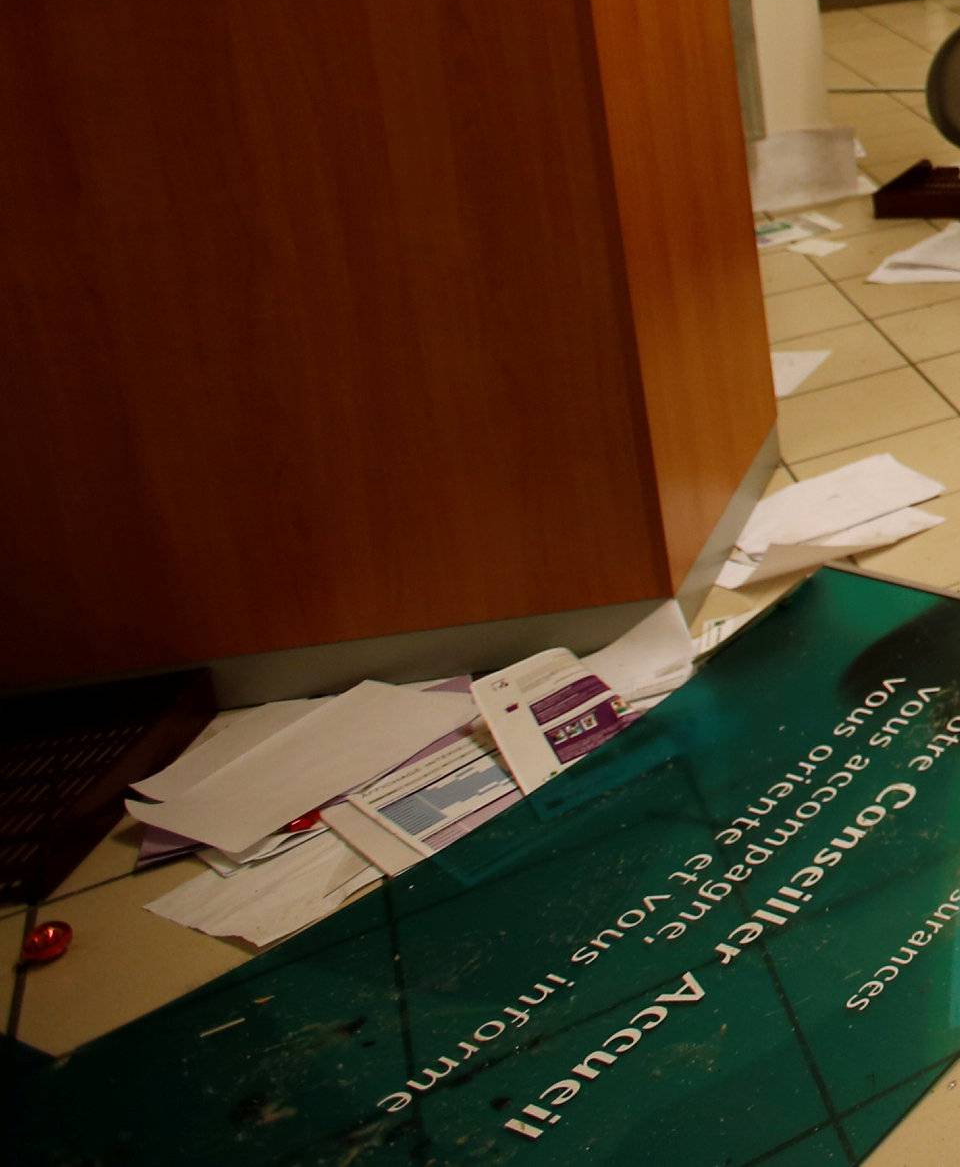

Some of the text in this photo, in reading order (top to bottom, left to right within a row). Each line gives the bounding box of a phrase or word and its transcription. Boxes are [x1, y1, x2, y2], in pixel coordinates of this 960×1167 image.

[377, 676, 907, 1113] vous oriente et vous informe
[642, 686, 942, 945] vous accompagne,
[714, 782, 917, 965] Conseiller
[504, 971, 706, 1139] Accueil
